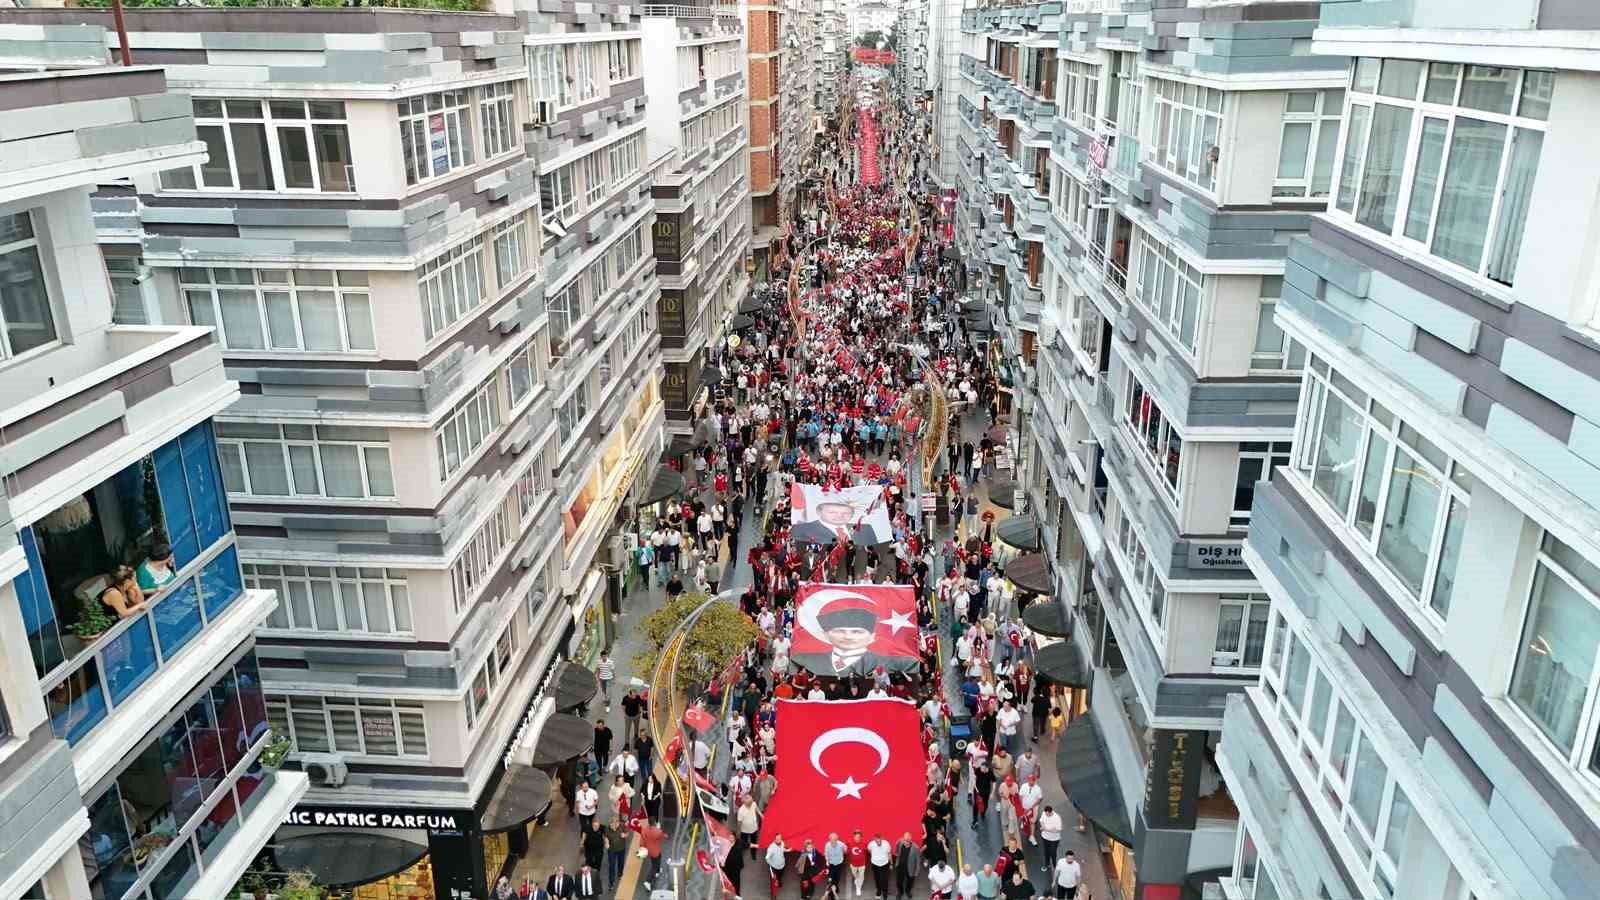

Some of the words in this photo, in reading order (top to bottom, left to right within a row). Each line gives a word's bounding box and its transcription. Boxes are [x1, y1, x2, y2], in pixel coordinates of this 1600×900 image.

[1198, 545, 1223, 558] DİŞ
[314, 811, 379, 827] PATRIC
[381, 814, 457, 829] PARFUM
